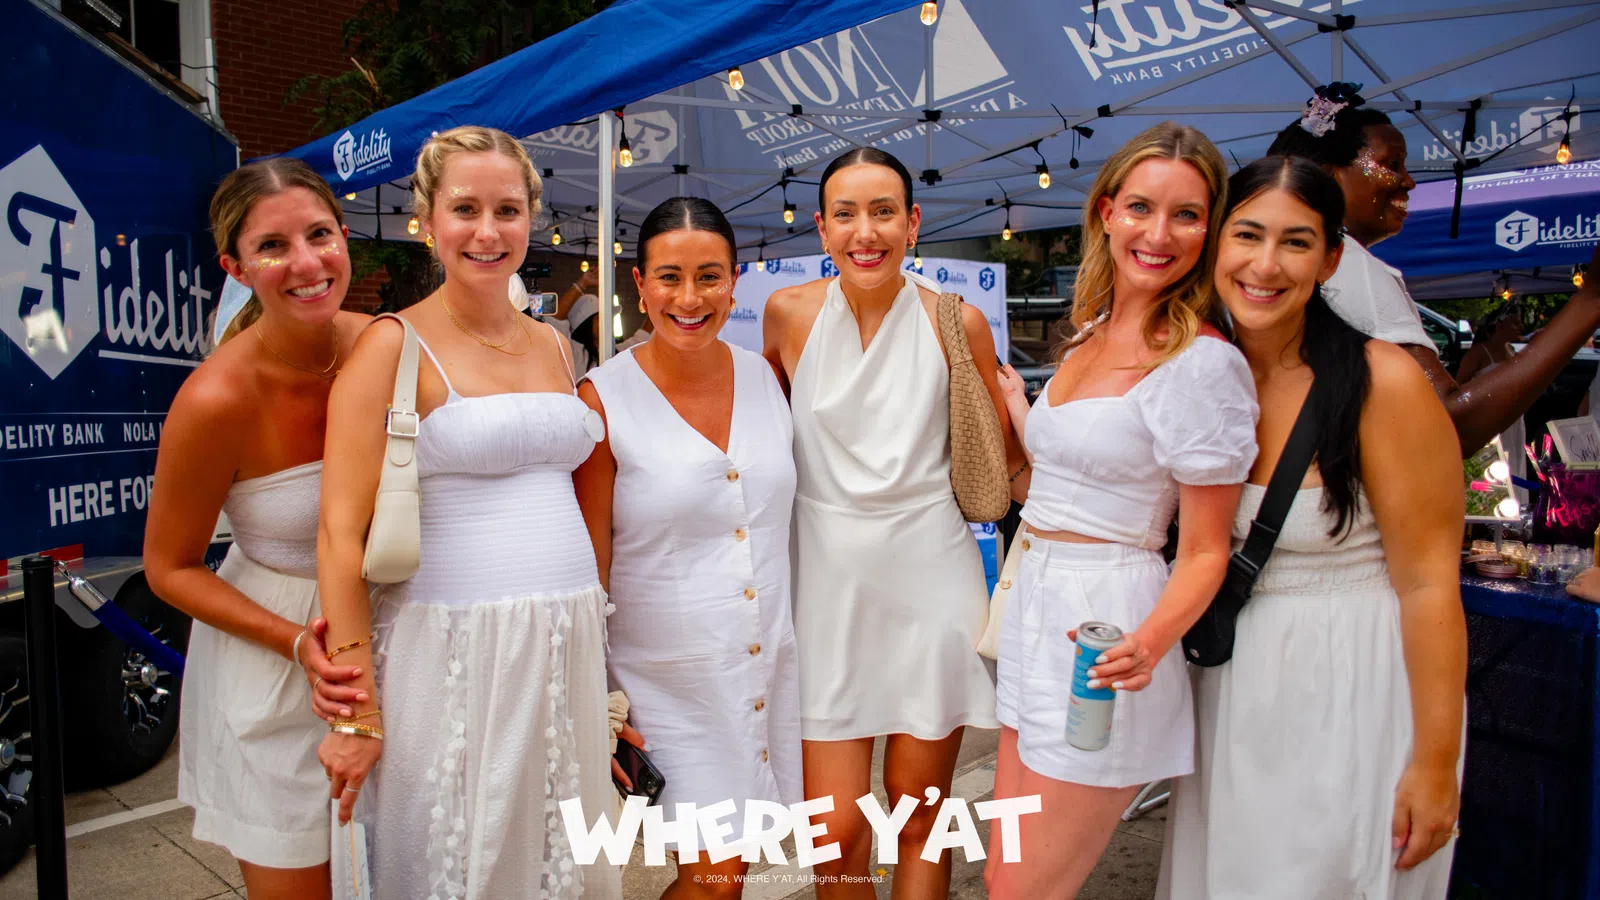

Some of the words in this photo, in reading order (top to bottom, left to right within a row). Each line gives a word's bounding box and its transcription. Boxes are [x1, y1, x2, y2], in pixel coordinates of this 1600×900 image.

[337, 127, 393, 174] Fidelity
[1532, 162, 1600, 174] LENDIN
[63, 423, 104, 446] BANK
[123, 422, 156, 442] NOLA
[48, 480, 115, 527] HERE
